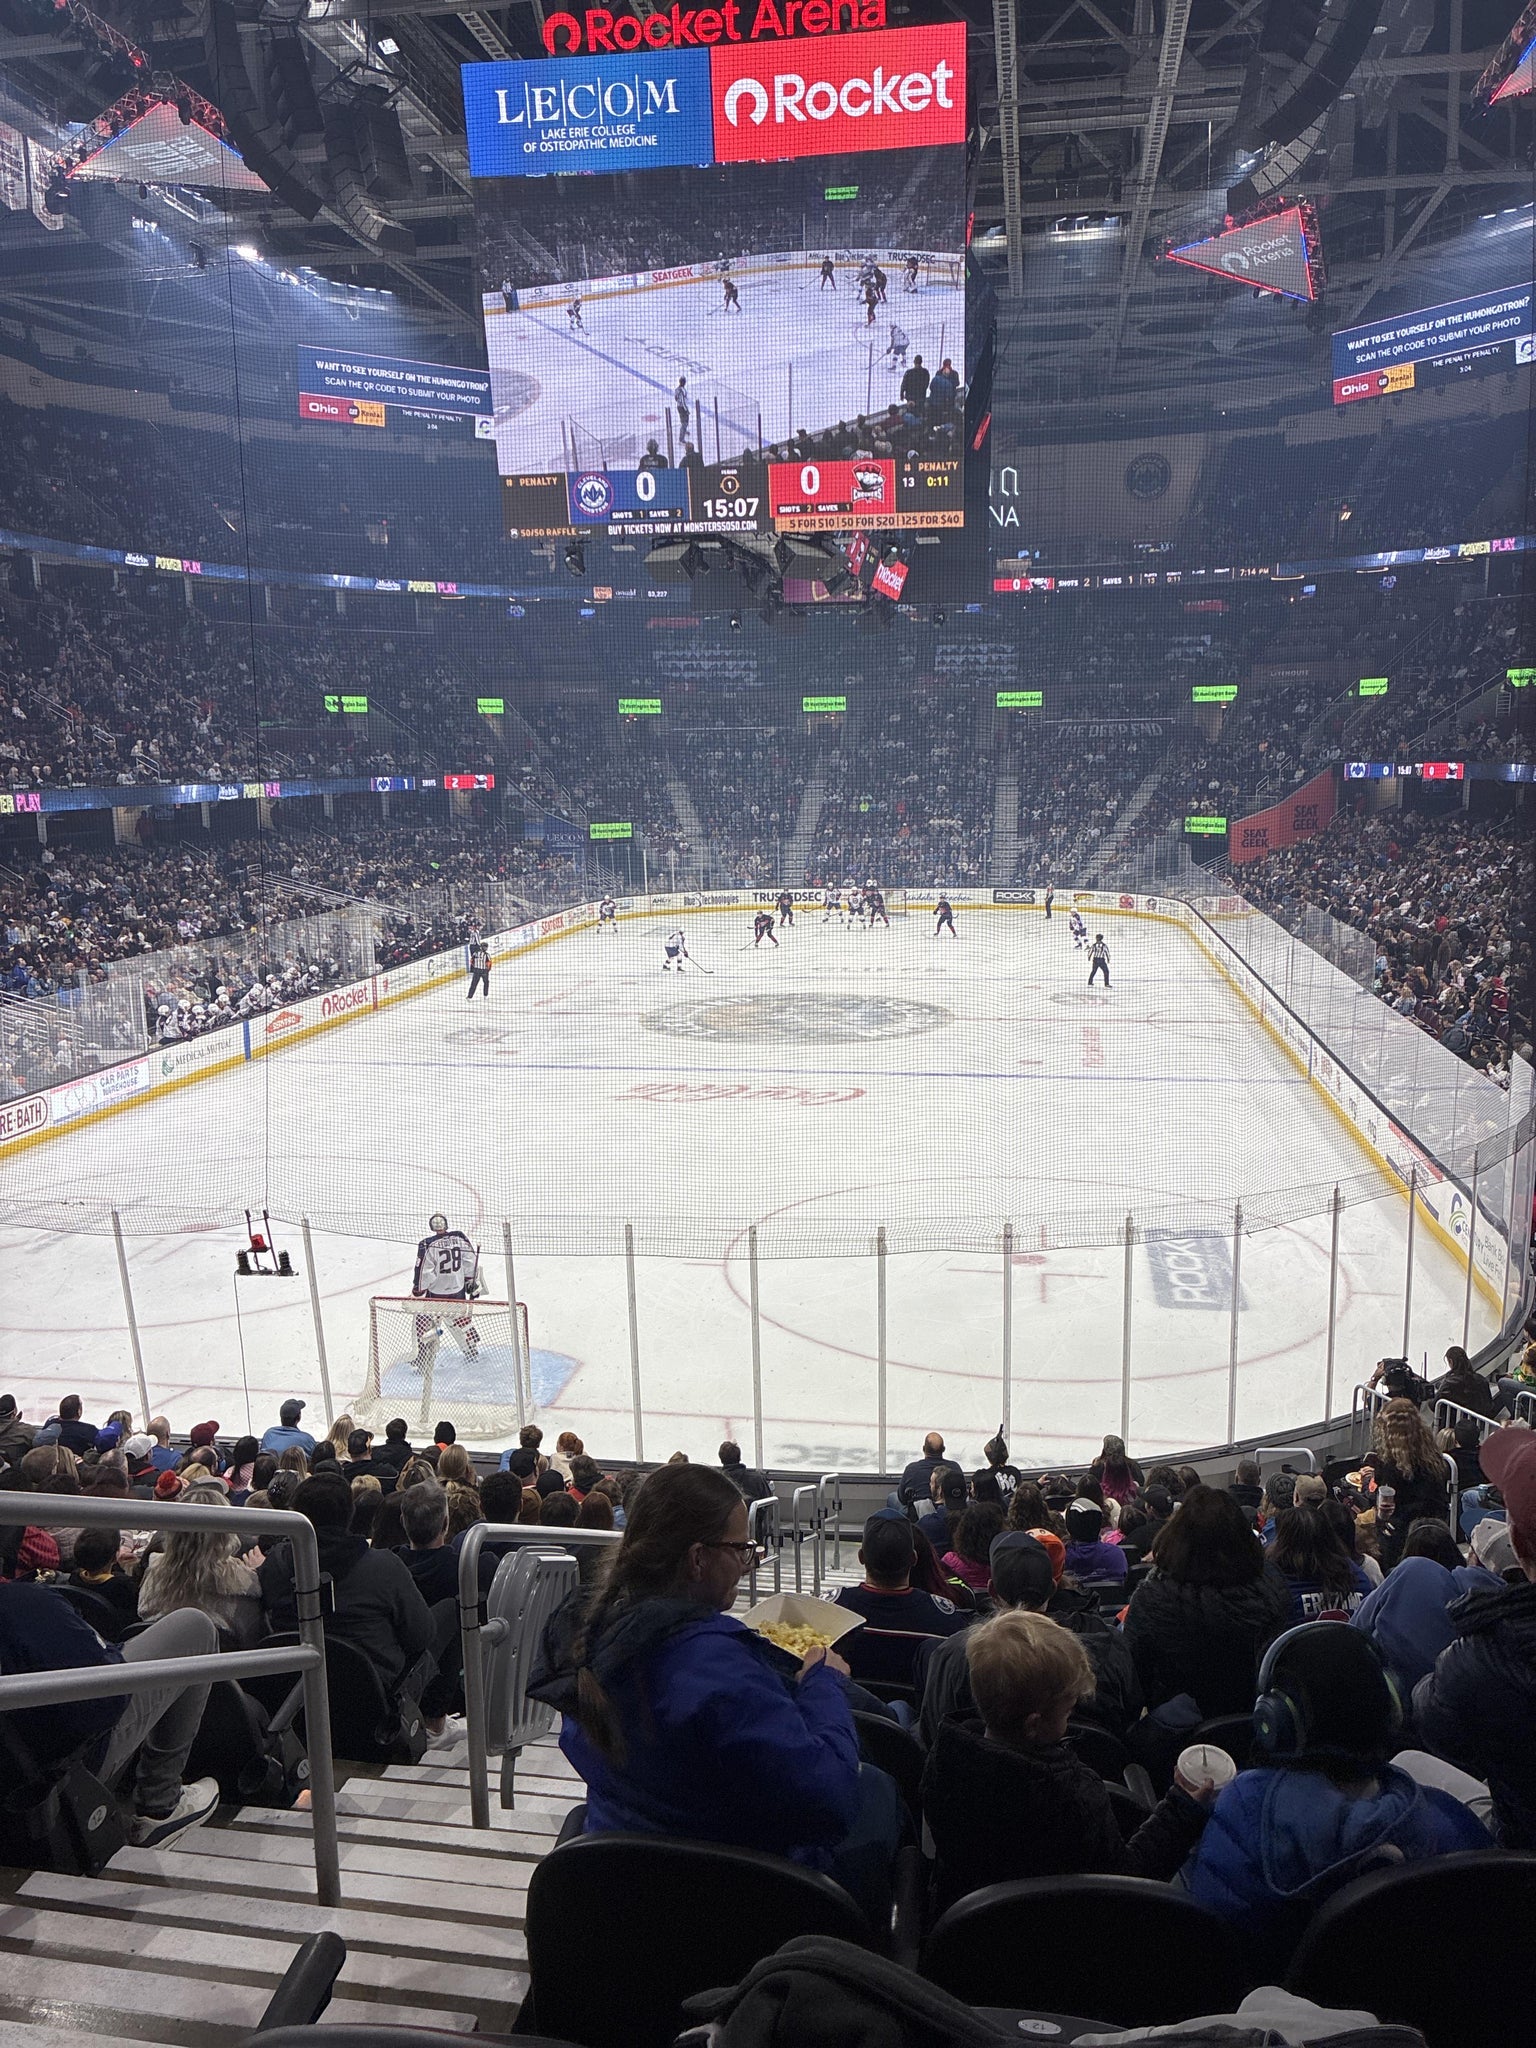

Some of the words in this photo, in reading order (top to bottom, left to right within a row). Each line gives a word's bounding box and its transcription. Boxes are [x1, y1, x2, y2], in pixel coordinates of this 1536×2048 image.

[588, 4, 740, 52] Rocket
[750, 0, 886, 38] Arena
[774, 59, 954, 123] Rocket
[541, 128, 566, 140] LAKE
[569, 127, 589, 138] ERIE
[592, 124, 636, 137] COLLEGE
[523, 142, 537, 153] OF
[540, 138, 607, 152] OSTEOPATHIC
[609, 135, 658, 148] MEDICINE
[1242, 234, 1292, 258] Rocket
[1252, 248, 1294, 267] Arena
[652, 267, 694, 283] SEATGEEK
[1348, 337, 1370, 351] WANT
[1371, 333, 1381, 344] TO
[1381, 330, 1395, 342] SEE
[1396, 321, 1434, 338] YOURSELF
[1435, 318, 1445, 329] ON
[1447, 313, 1462, 326] THE
[1464, 296, 1530, 322] HUMONGOTRON?
[1355, 352, 1377, 364] SCAN
[1378, 347, 1391, 358] THE
[1392, 344, 1403, 357] QR
[1404, 340, 1426, 353] CODE
[1427, 337, 1438, 346] TO
[1438, 328, 1467, 343] SUBMIT
[1468, 323, 1491, 336] YOUR
[1492, 316, 1521, 331] PHOTO
[1432, 359, 1444, 368] THE
[316, 360, 339, 372] WANT
[341, 363, 352, 374] TO
[352, 366, 367, 376] SEE
[367, 367, 405, 381] YOURSELF
[417, 373, 431, 384] THE
[325, 377, 347, 388] SCAN
[348, 379, 362, 389] THE
[363, 381, 375, 392] QR
[375, 383, 396, 394] CODE
[397, 386, 408, 395] TO
[408, 387, 436, 398] SUBMIT
[436, 389, 455, 401] YOUR
[456, 393, 481, 404] PHOTO
[1341, 382, 1369, 396] Ohio
[308, 402, 339, 415] Ohio
[919, 461, 959, 472] PENALTY
[519, 477, 558, 487] PENALTY
[636, 471, 656, 501] 0
[800, 465, 820, 495] 0
[902, 478, 915, 488] 13
[927, 476, 949, 487] 0:11
[612, 511, 633, 519] SHOTS
[649, 510, 670, 518] SAVES
[676, 509, 682, 517] 2
[703, 498, 759, 518] 15:07
[779, 505, 801, 513] SHOTS
[806, 504, 812, 512] 2
[817, 504, 838, 512] SAVES
[608, 525, 622, 535] BUY
[624, 523, 653, 534] TICKETS
[655, 523, 672, 533] NOW
[673, 523, 683, 533] AT
[789, 520, 796, 529] 5
[798, 519, 816, 529] FOR
[841, 517, 853, 528] 50
[856, 516, 874, 526] FOR
[902, 515, 918, 525] 125
[920, 514, 938, 525] FOR
[940, 513, 960, 525] $40
[521, 529, 545, 537] 50/50
[546, 527, 577, 537] RAFFLE
[1458, 541, 1490, 556] POWER
[1492, 537, 1515, 551] PLAY
[155, 556, 182, 571] POWER
[183, 560, 201, 574] PLAY
[1240, 567, 1256, 576] 7:14
[408, 581, 436, 593] POWER
[437, 582, 457, 593] PLAY
[1012, 579, 1020, 590] 0
[1058, 580, 1079, 588] SHOTS
[1084, 578, 1090, 587] 2
[1383, 766, 1390, 775] 0
[1429, 766, 1435, 776] 0
[403, 779, 408, 789] 1
[451, 778, 459, 788] 2
[16, 794, 41, 812] PLAY
[1295, 805, 1319, 817] SEAT
[1293, 819, 1319, 831] GEEK
[546, 833, 585, 842] LECOM
[1243, 829, 1268, 838] SEAT
[1241, 839, 1270, 848] GEEK
[332, 985, 369, 1013] Rocket
[100, 1074, 115, 1088] CAR
[116, 1066, 140, 1083] PARTS
[102, 1077, 138, 1097] WAREHOUSE
[439, 1246, 461, 1274] 28
